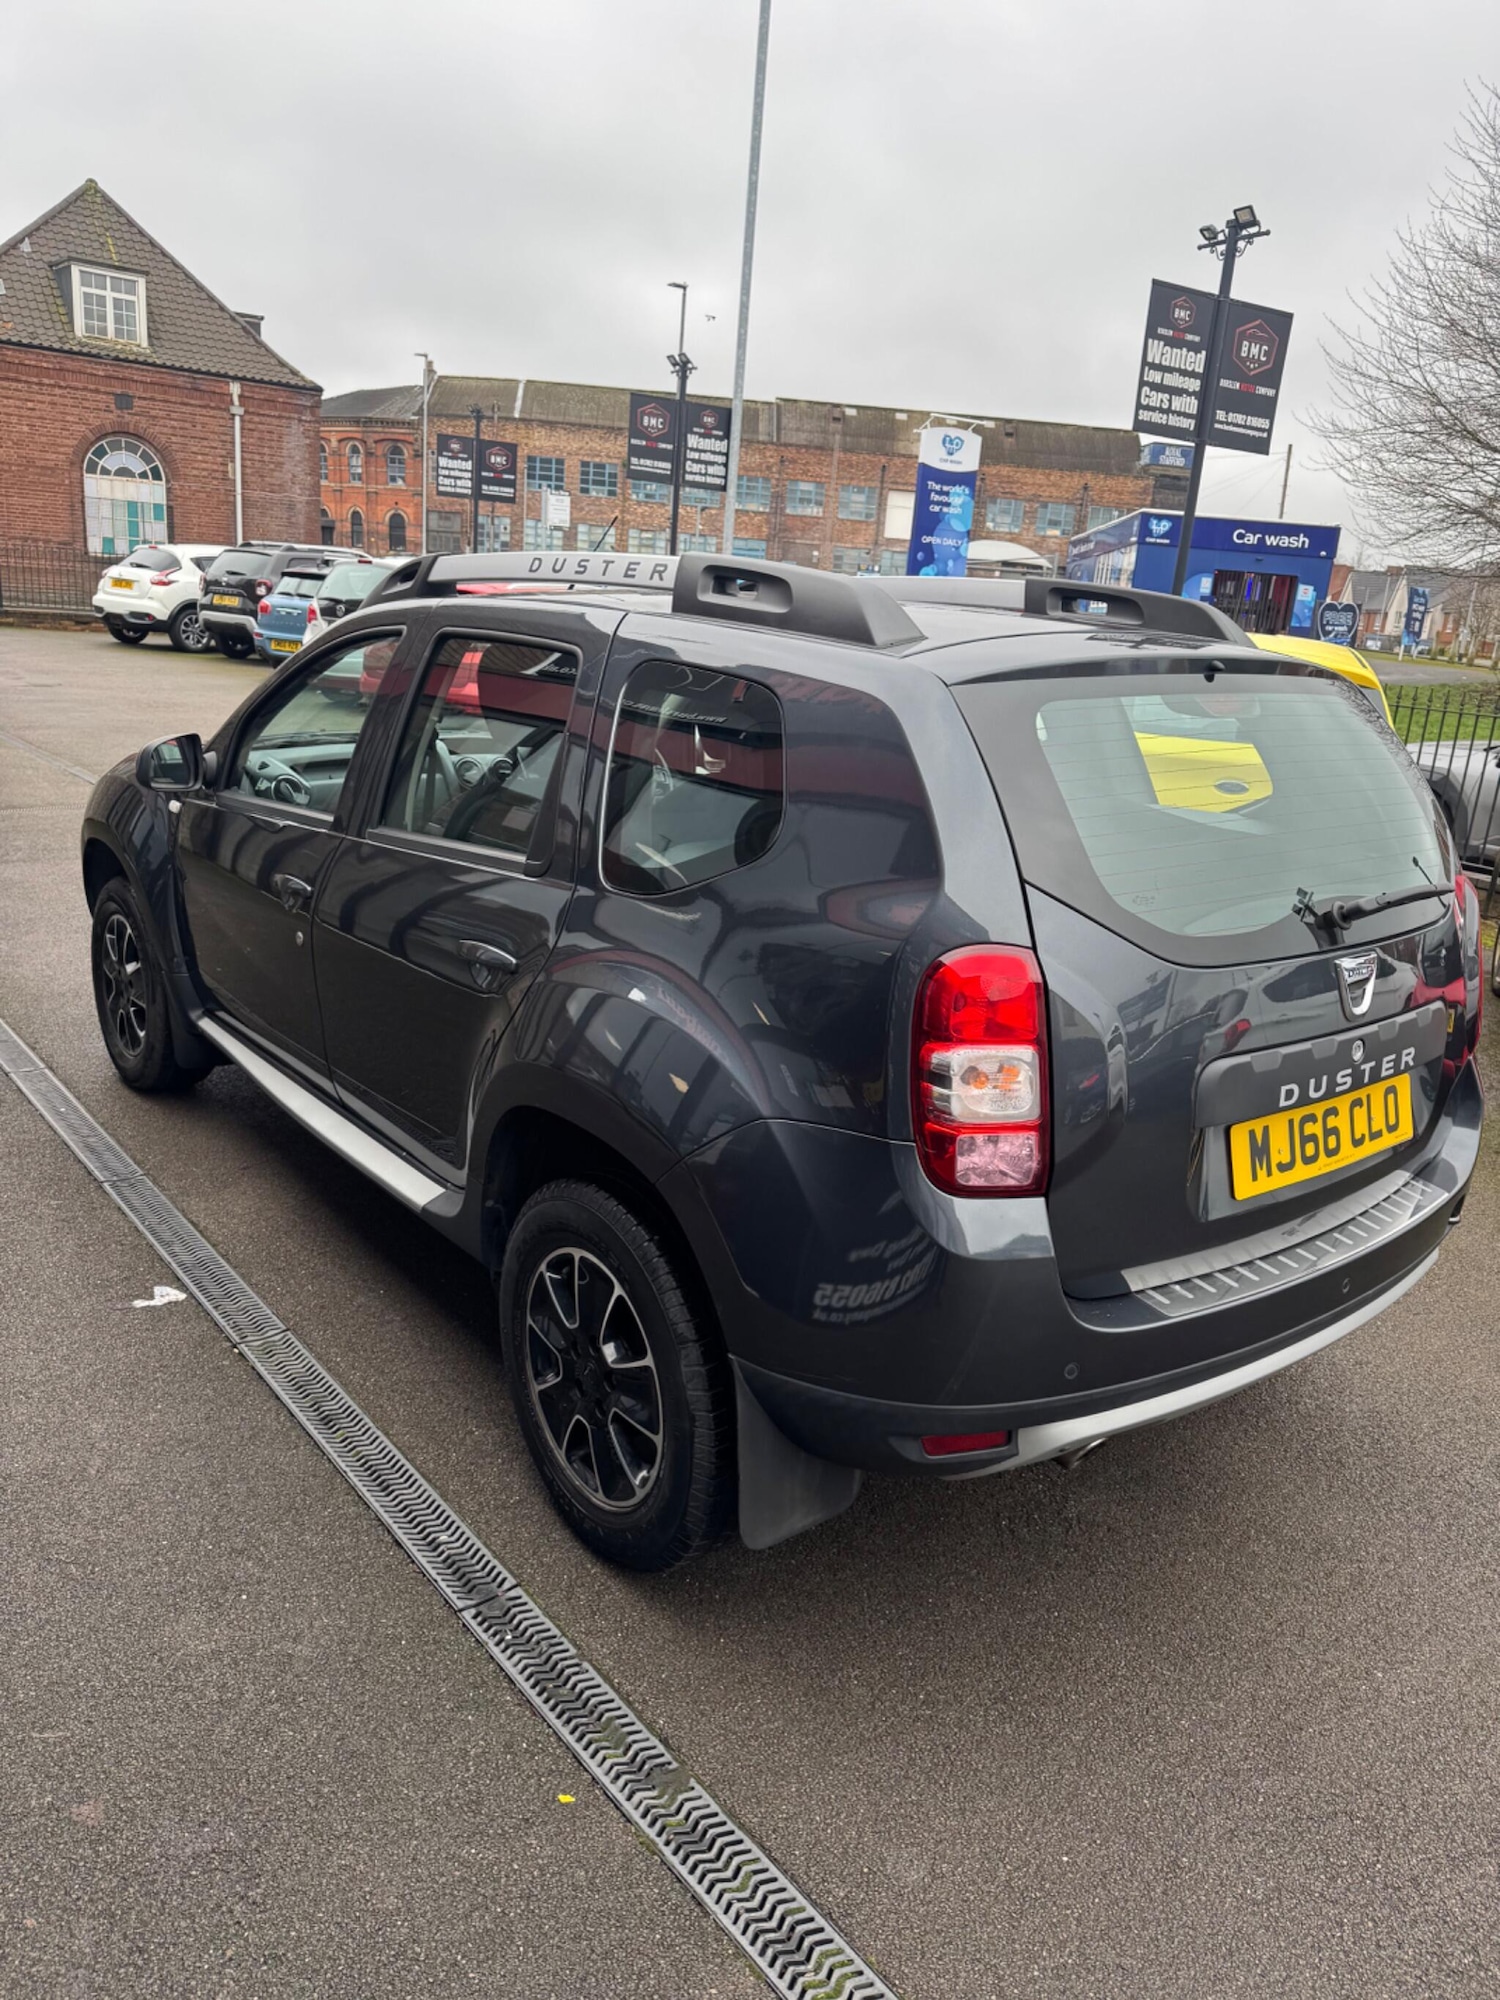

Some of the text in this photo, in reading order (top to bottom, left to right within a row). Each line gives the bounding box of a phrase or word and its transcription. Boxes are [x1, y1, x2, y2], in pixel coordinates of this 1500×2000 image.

[1174, 308, 1190, 320] BMC
[1146, 338, 1206, 373] Wanted
[1241, 340, 1268, 361] BMC
[1143, 366, 1201, 392] Low mileage
[1141, 386, 1198, 414] Cars with
[643, 416, 664, 428] BMC
[1138, 409, 1168, 425] service
[1167, 411, 1195, 431] history
[687, 433, 728, 453] Wanted
[438, 456, 472, 470] Wanted
[686, 449, 700, 459] Low
[685, 460, 706, 474] Cars
[706, 464, 726, 476] with
[927, 481, 941, 491] The
[929, 504, 963, 514] car wash
[921, 535, 941, 545] OPEN
[1232, 528, 1310, 548] Car wash
[528, 557, 668, 581] DUSTER
[1279, 1046, 1416, 1108] DUSTER
[1248, 1084, 1401, 1183] MJ66 CLO
